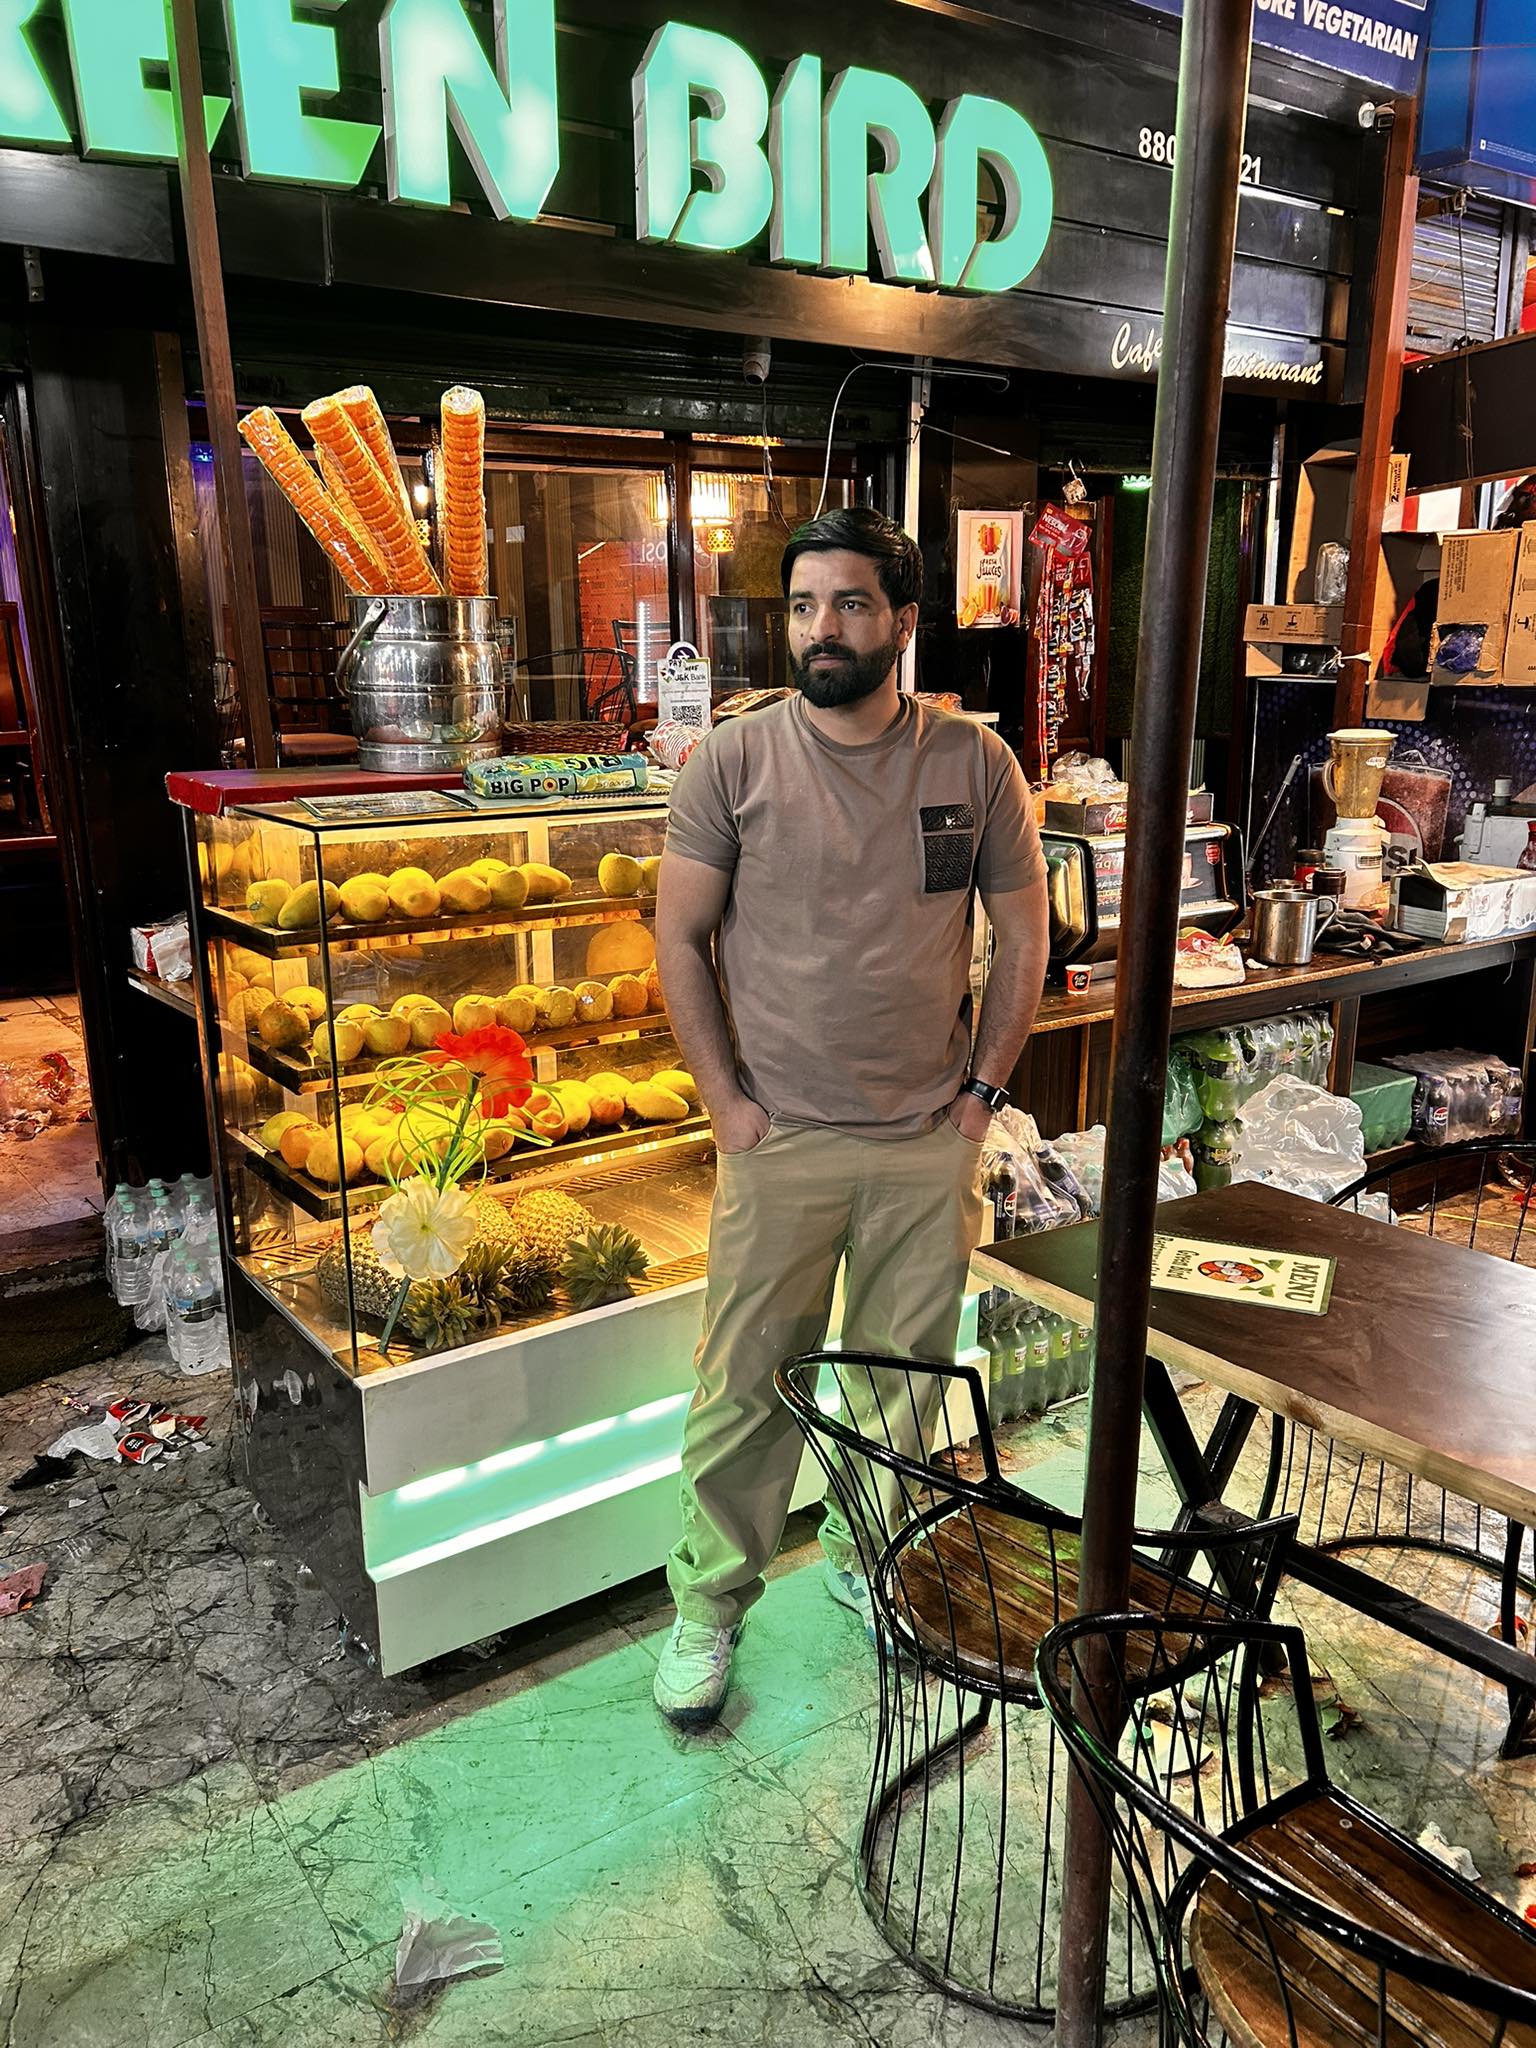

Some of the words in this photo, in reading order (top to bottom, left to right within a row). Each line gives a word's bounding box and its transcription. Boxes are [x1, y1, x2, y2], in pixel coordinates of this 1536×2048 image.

[1303, 0, 1420, 62] VEGETARIAN
[631, 20, 1053, 292] BIRD
[1223, 351, 1324, 386] estaurant
[690, 673, 706, 681] Bank
[490, 779, 524, 795] BIG
[530, 776, 570, 793] POP
[1165, 1261, 1193, 1281] Bird
[1174, 1249, 1200, 1269] Green
[1284, 1261, 1321, 1304] MENU
